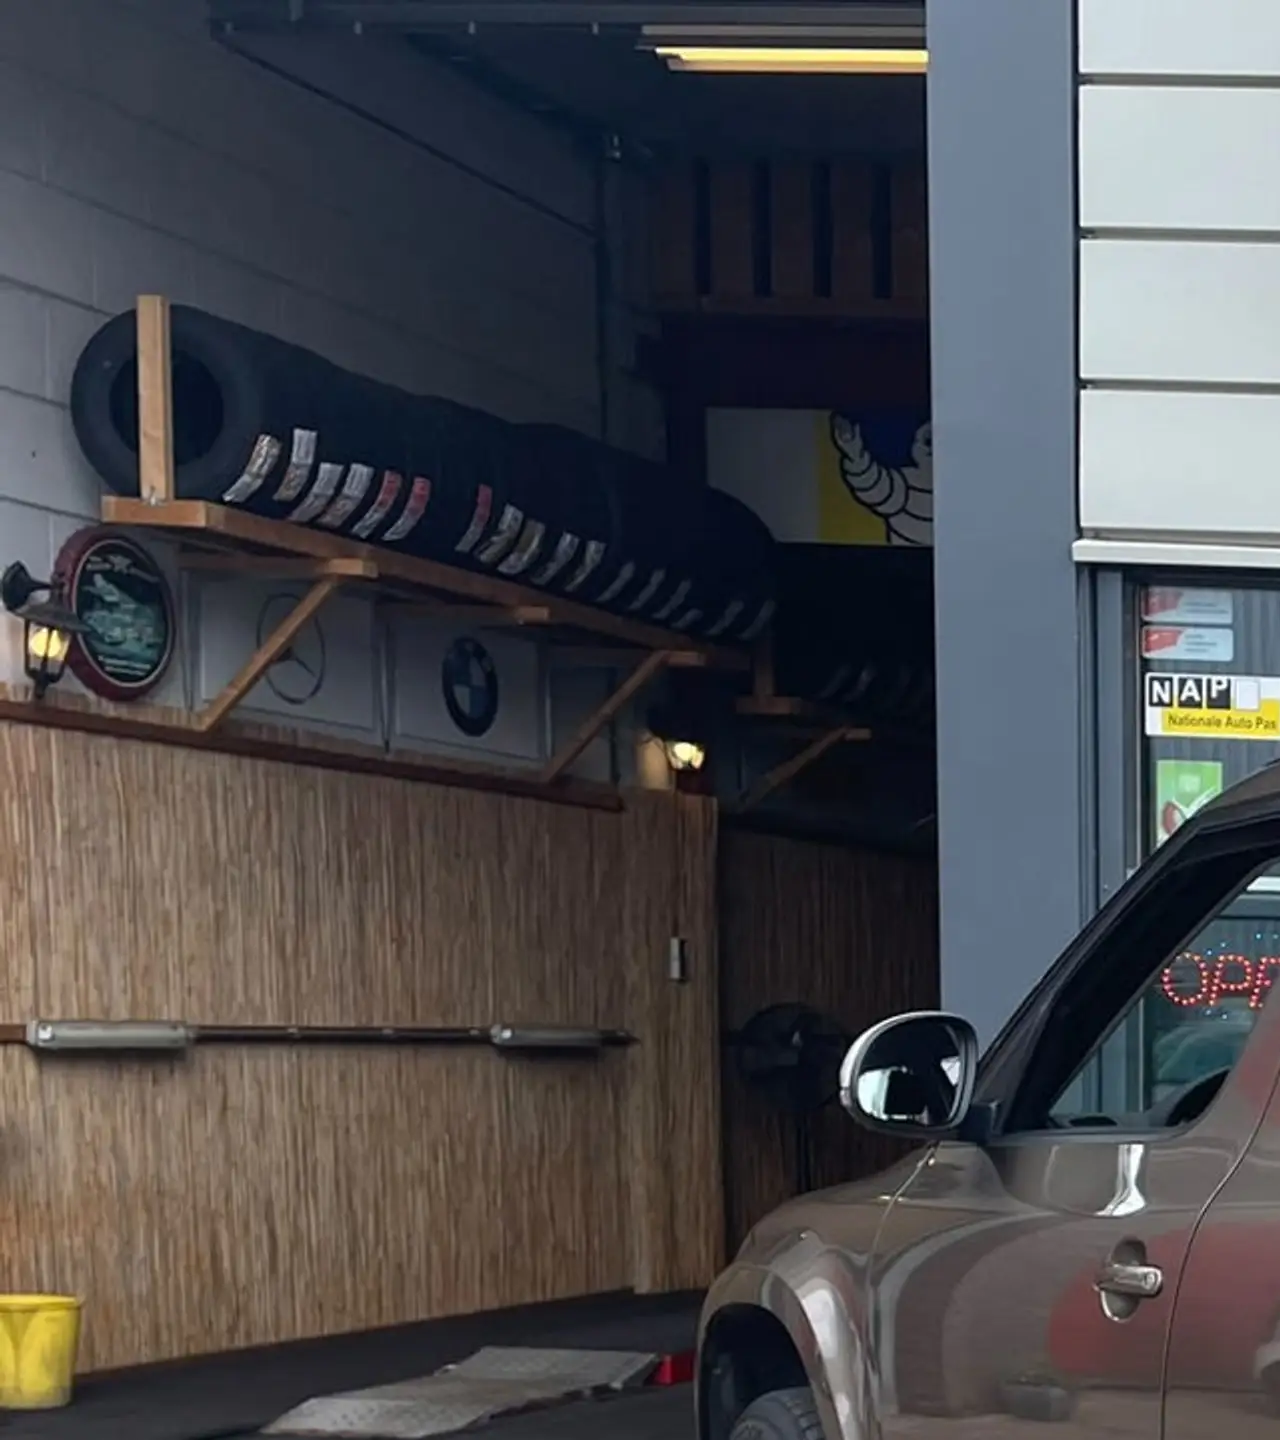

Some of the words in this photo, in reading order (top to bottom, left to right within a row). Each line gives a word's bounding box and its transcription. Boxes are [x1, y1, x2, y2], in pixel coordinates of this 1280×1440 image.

[1167, 713, 1222, 728] Nationale
[1225, 716, 1253, 729] Auto
[1255, 717, 1277, 730] Pas
